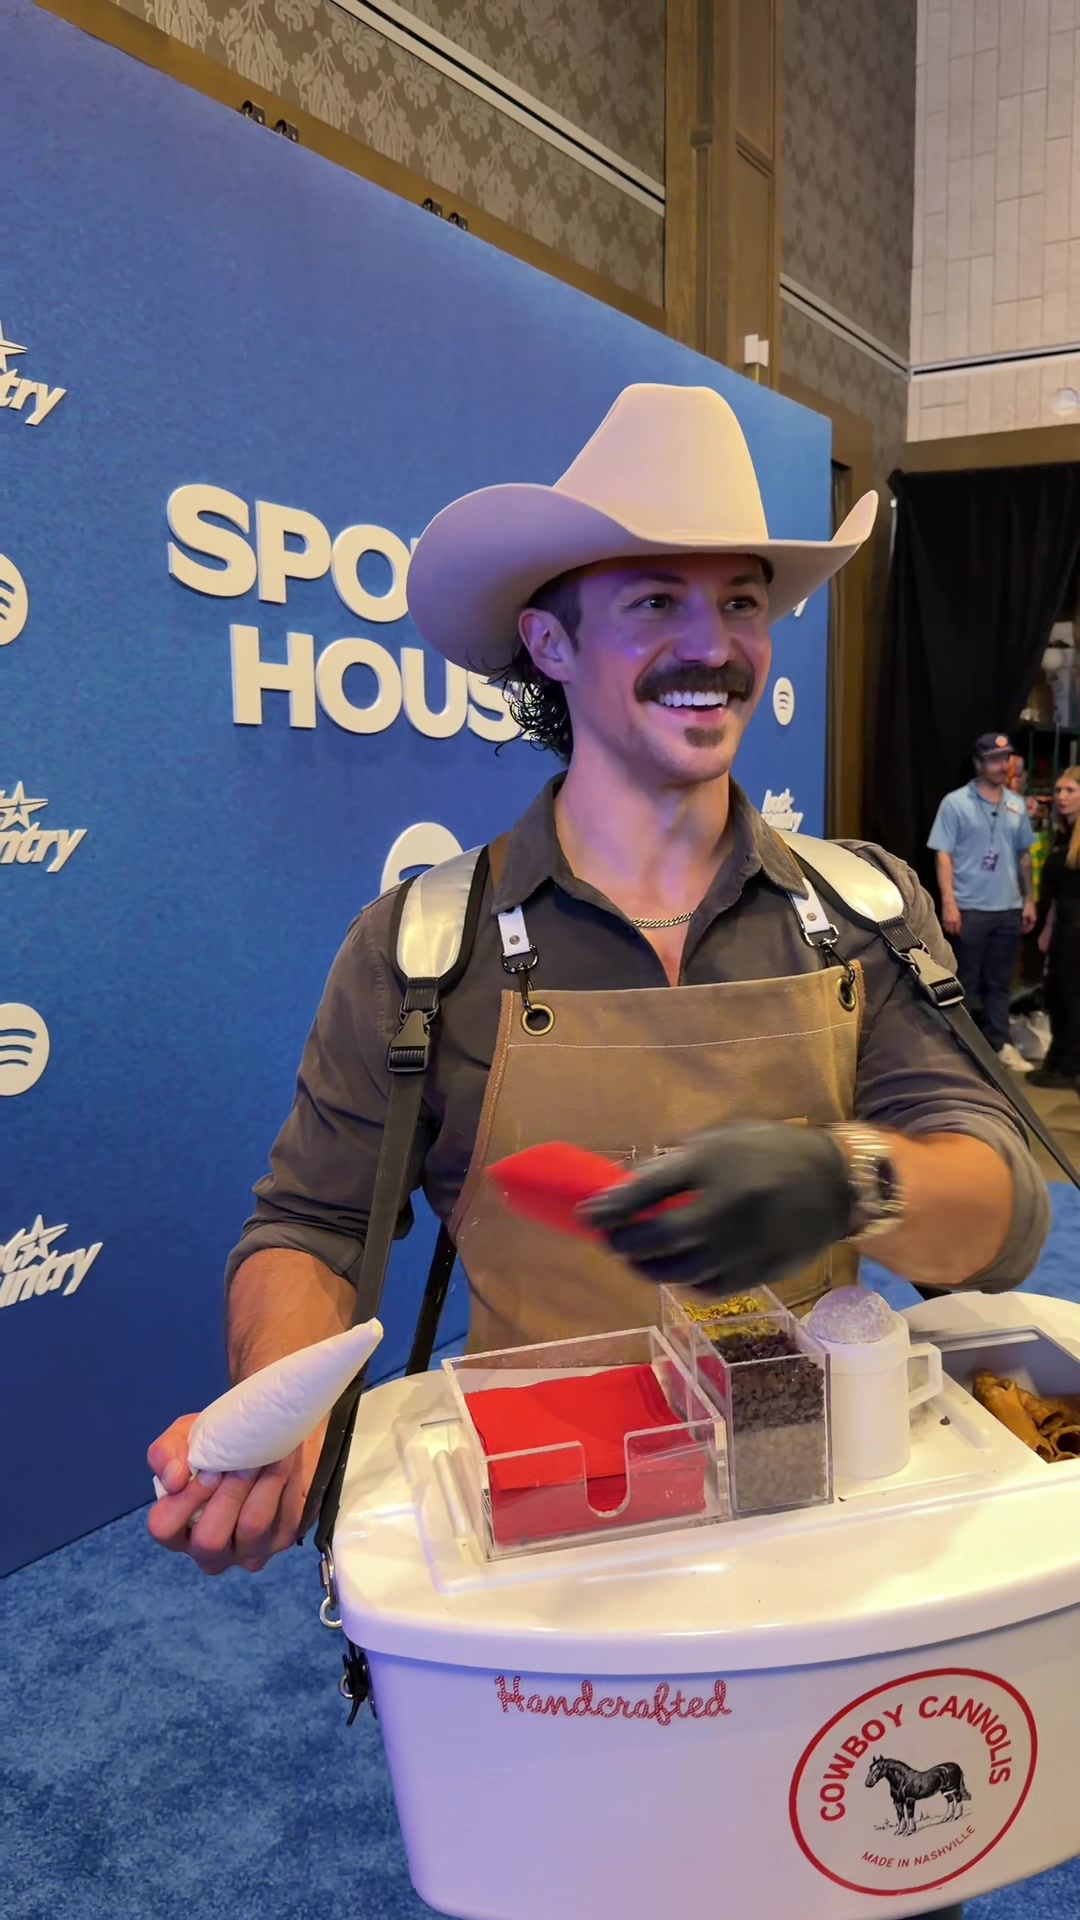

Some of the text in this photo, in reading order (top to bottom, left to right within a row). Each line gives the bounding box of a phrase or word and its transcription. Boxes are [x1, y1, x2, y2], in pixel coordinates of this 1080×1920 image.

[167, 483, 420, 622] SPO
[494, 1675, 732, 1726] Handcrafted
[819, 1695, 1013, 1822] COWBOY CANNOLIS
[861, 1825, 976, 1868] MADE IN NASHVILLE
